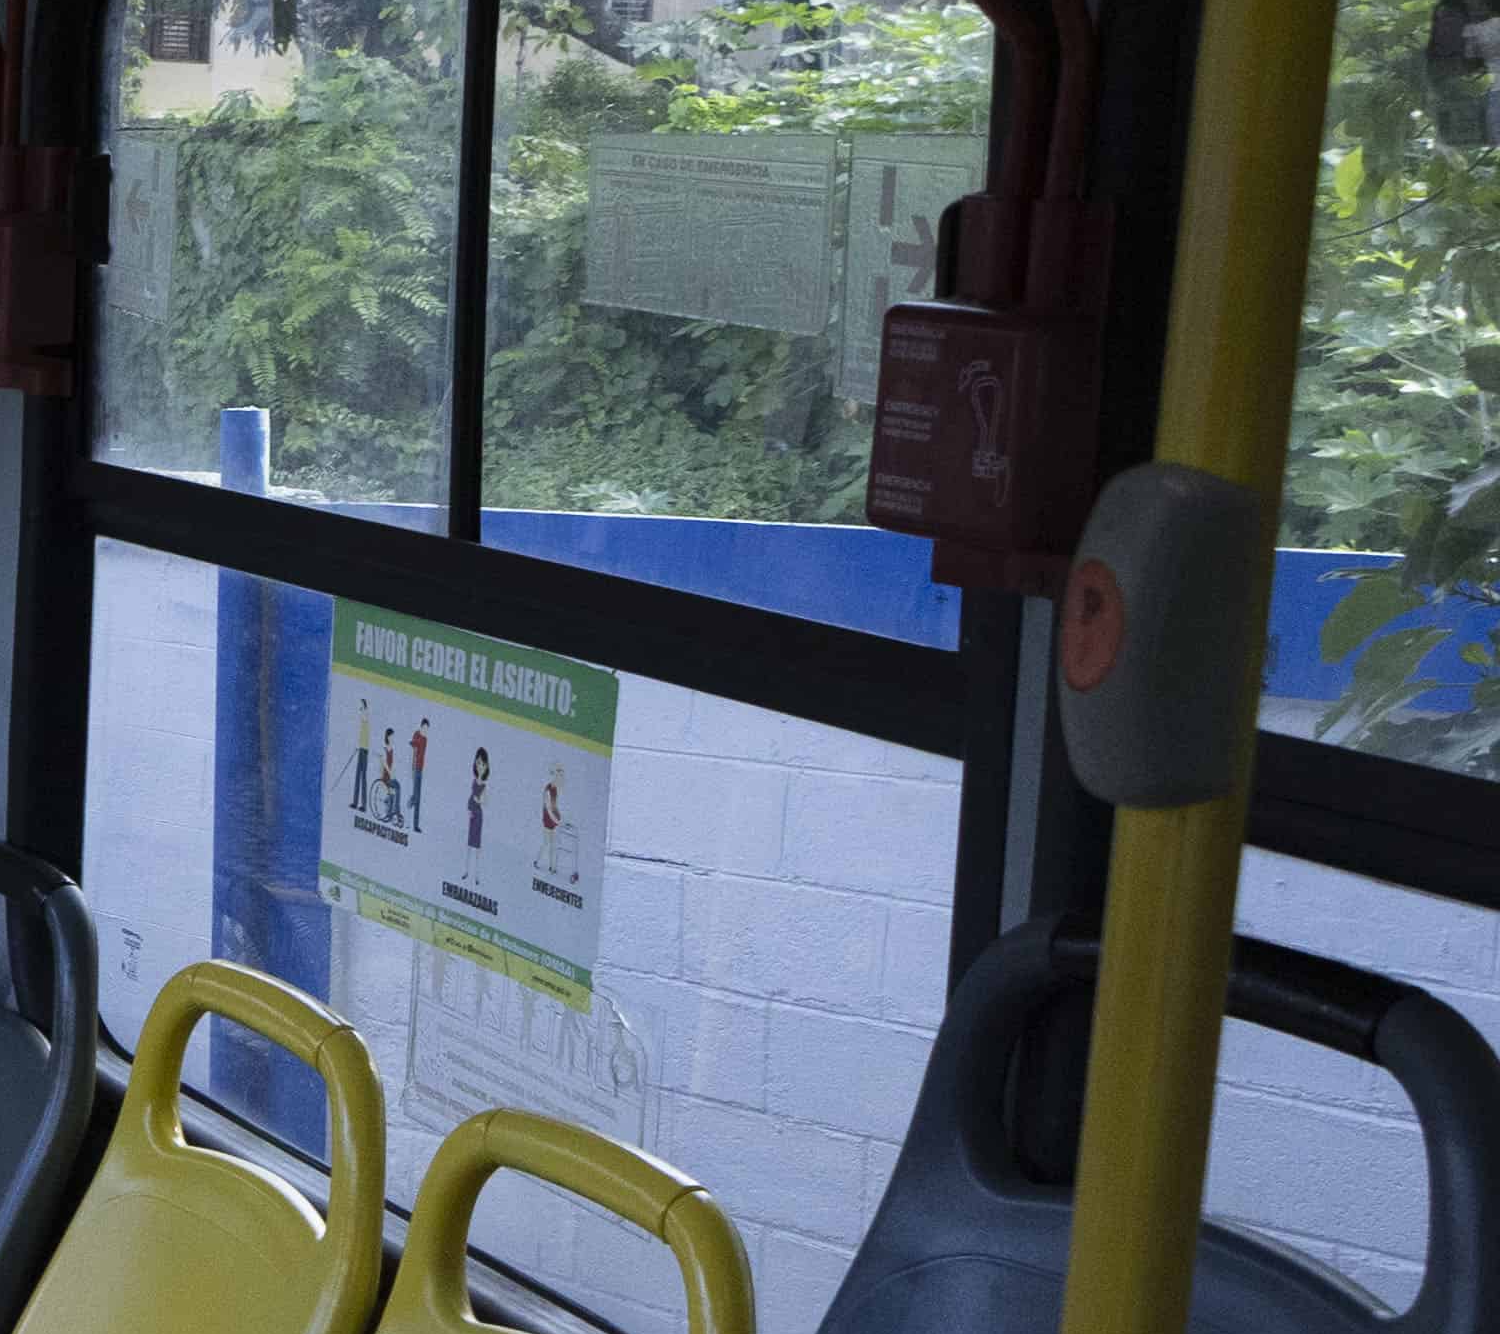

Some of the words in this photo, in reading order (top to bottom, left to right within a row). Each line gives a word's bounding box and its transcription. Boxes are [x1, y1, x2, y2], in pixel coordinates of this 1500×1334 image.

[355, 620, 407, 668] FAVOR
[411, 636, 467, 684] CEDER
[469, 653, 489, 691] EL
[491, 660, 577, 717] ASIENTO:
[441, 880, 499, 916] EMBARAZADAS
